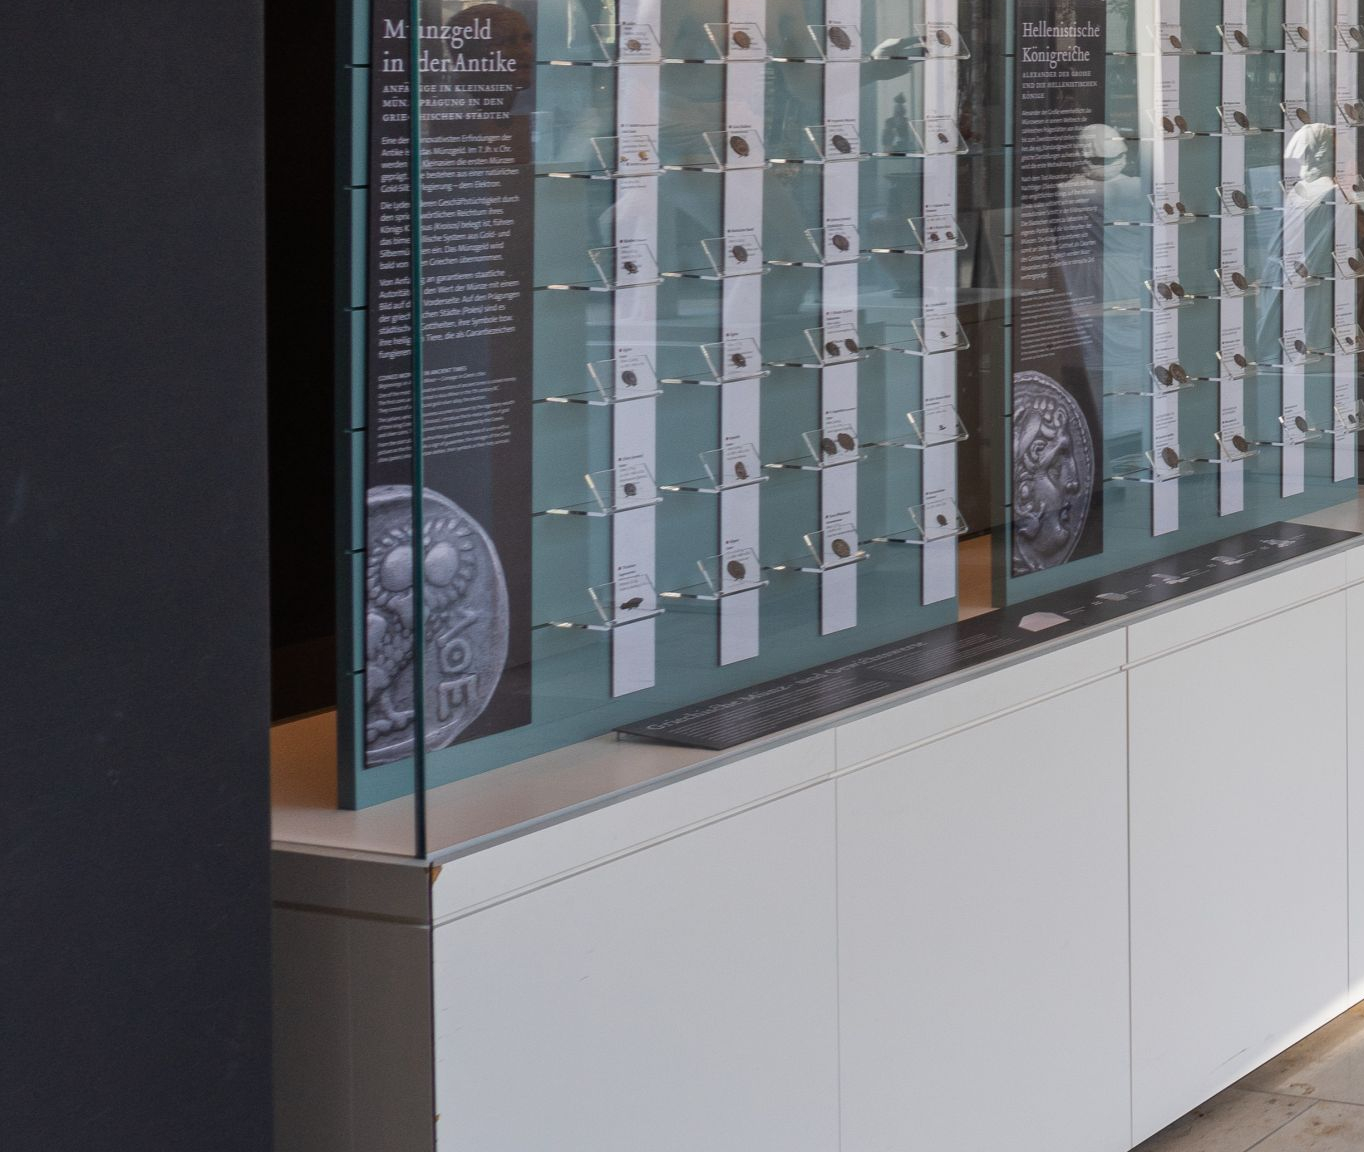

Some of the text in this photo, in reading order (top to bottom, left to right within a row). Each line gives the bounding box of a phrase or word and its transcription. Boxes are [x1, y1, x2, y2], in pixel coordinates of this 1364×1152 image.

[1022, 20, 1101, 38] Hellenistische
[382, 50, 518, 72] in der Antike
[1021, 45, 1091, 69] Königreiche
[440, 84, 451, 92] IN
[454, 84, 513, 93] KLEINASIEN
[468, 97, 481, 106] IN
[483, 97, 505, 106] DEN
[382, 108, 511, 122] GRIEHISCHEN STÄDTEN
